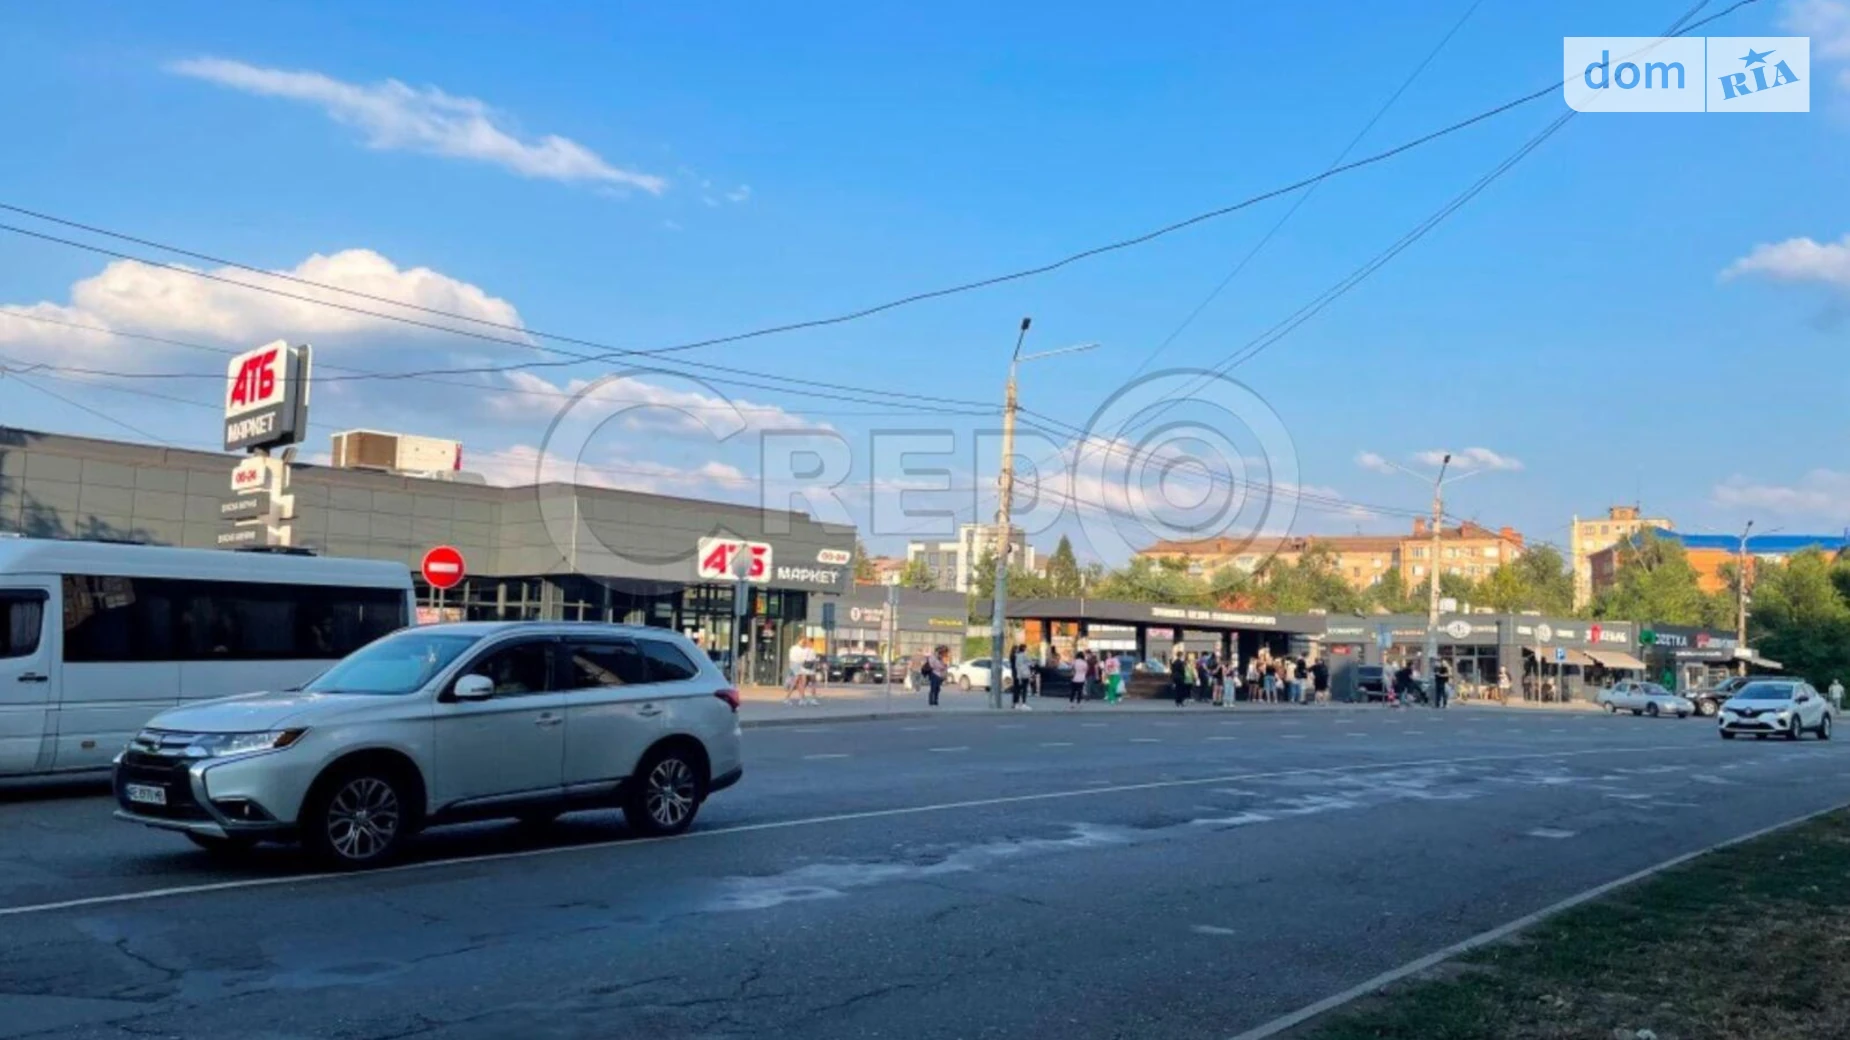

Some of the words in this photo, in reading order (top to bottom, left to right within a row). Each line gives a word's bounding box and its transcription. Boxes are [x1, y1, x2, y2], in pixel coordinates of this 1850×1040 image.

[231, 349, 278, 407] АТБ
[228, 412, 276, 443] МАРКЕТ
[777, 567, 840, 584] МАРКЕТ
